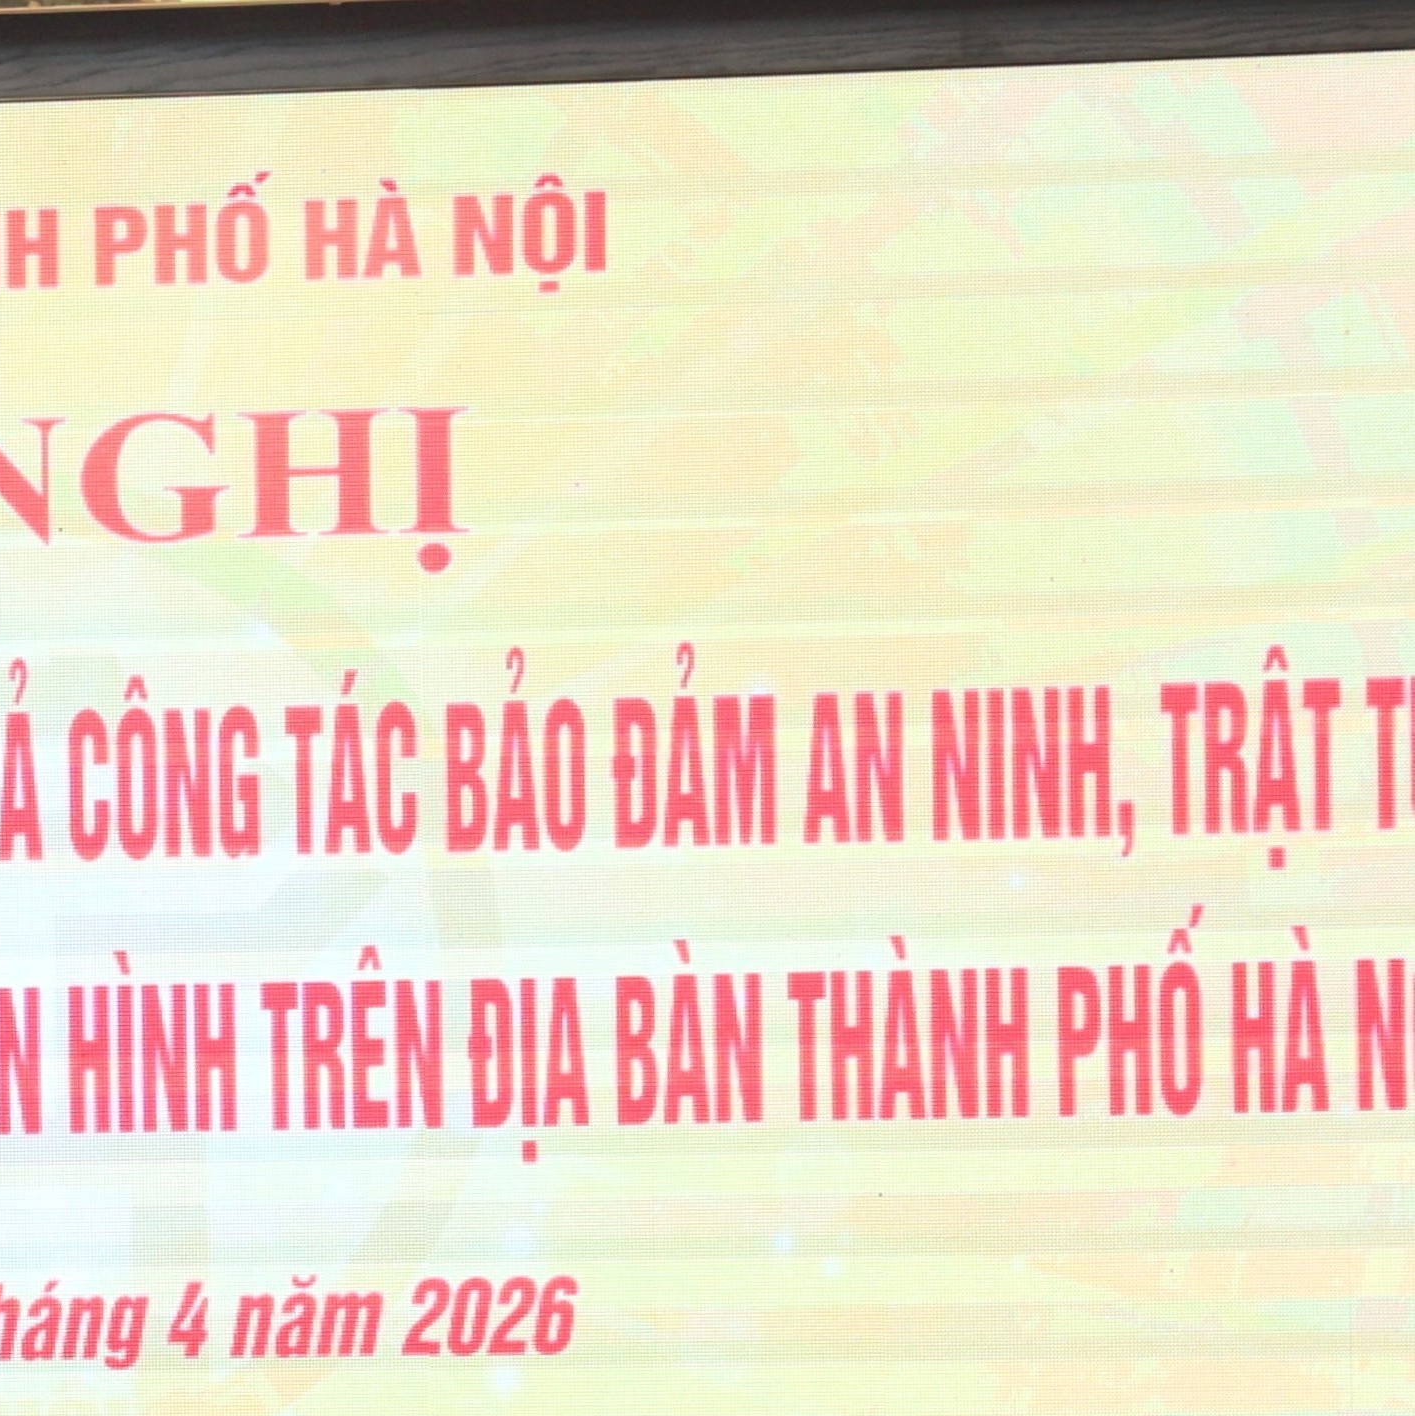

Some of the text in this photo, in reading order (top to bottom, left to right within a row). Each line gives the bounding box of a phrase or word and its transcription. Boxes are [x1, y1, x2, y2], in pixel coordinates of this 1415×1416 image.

[93, 169, 271, 287] PHỐ
[304, 178, 421, 281] HÀ
[453, 172, 608, 295] NỘI
[67, 674, 262, 862] CÔNG
[284, 669, 419, 856] TÁC
[444, 646, 588, 854] BẢO
[610, 641, 778, 850] ĐẢM
[802, 690, 906, 845] AN
[930, 684, 1136, 856] NINH,
[1158, 644, 1343, 871] TRẬT
[68, 949, 238, 1135] HÌNH
[260, 944, 445, 1132] TRÊN
[466, 975, 591, 1164] ĐỊA
[614, 938, 764, 1127] BÀN
[786, 934, 1031, 1123] THÀNH
[1056, 903, 1205, 1119] PHỐ
[1230, 923, 1331, 1115] HÀ
[1353, 956, 1415, 1112] N
[166, 1280, 209, 1359] 4
[229, 1276, 385, 1360] năm
[401, 1274, 579, 1358] 2026
